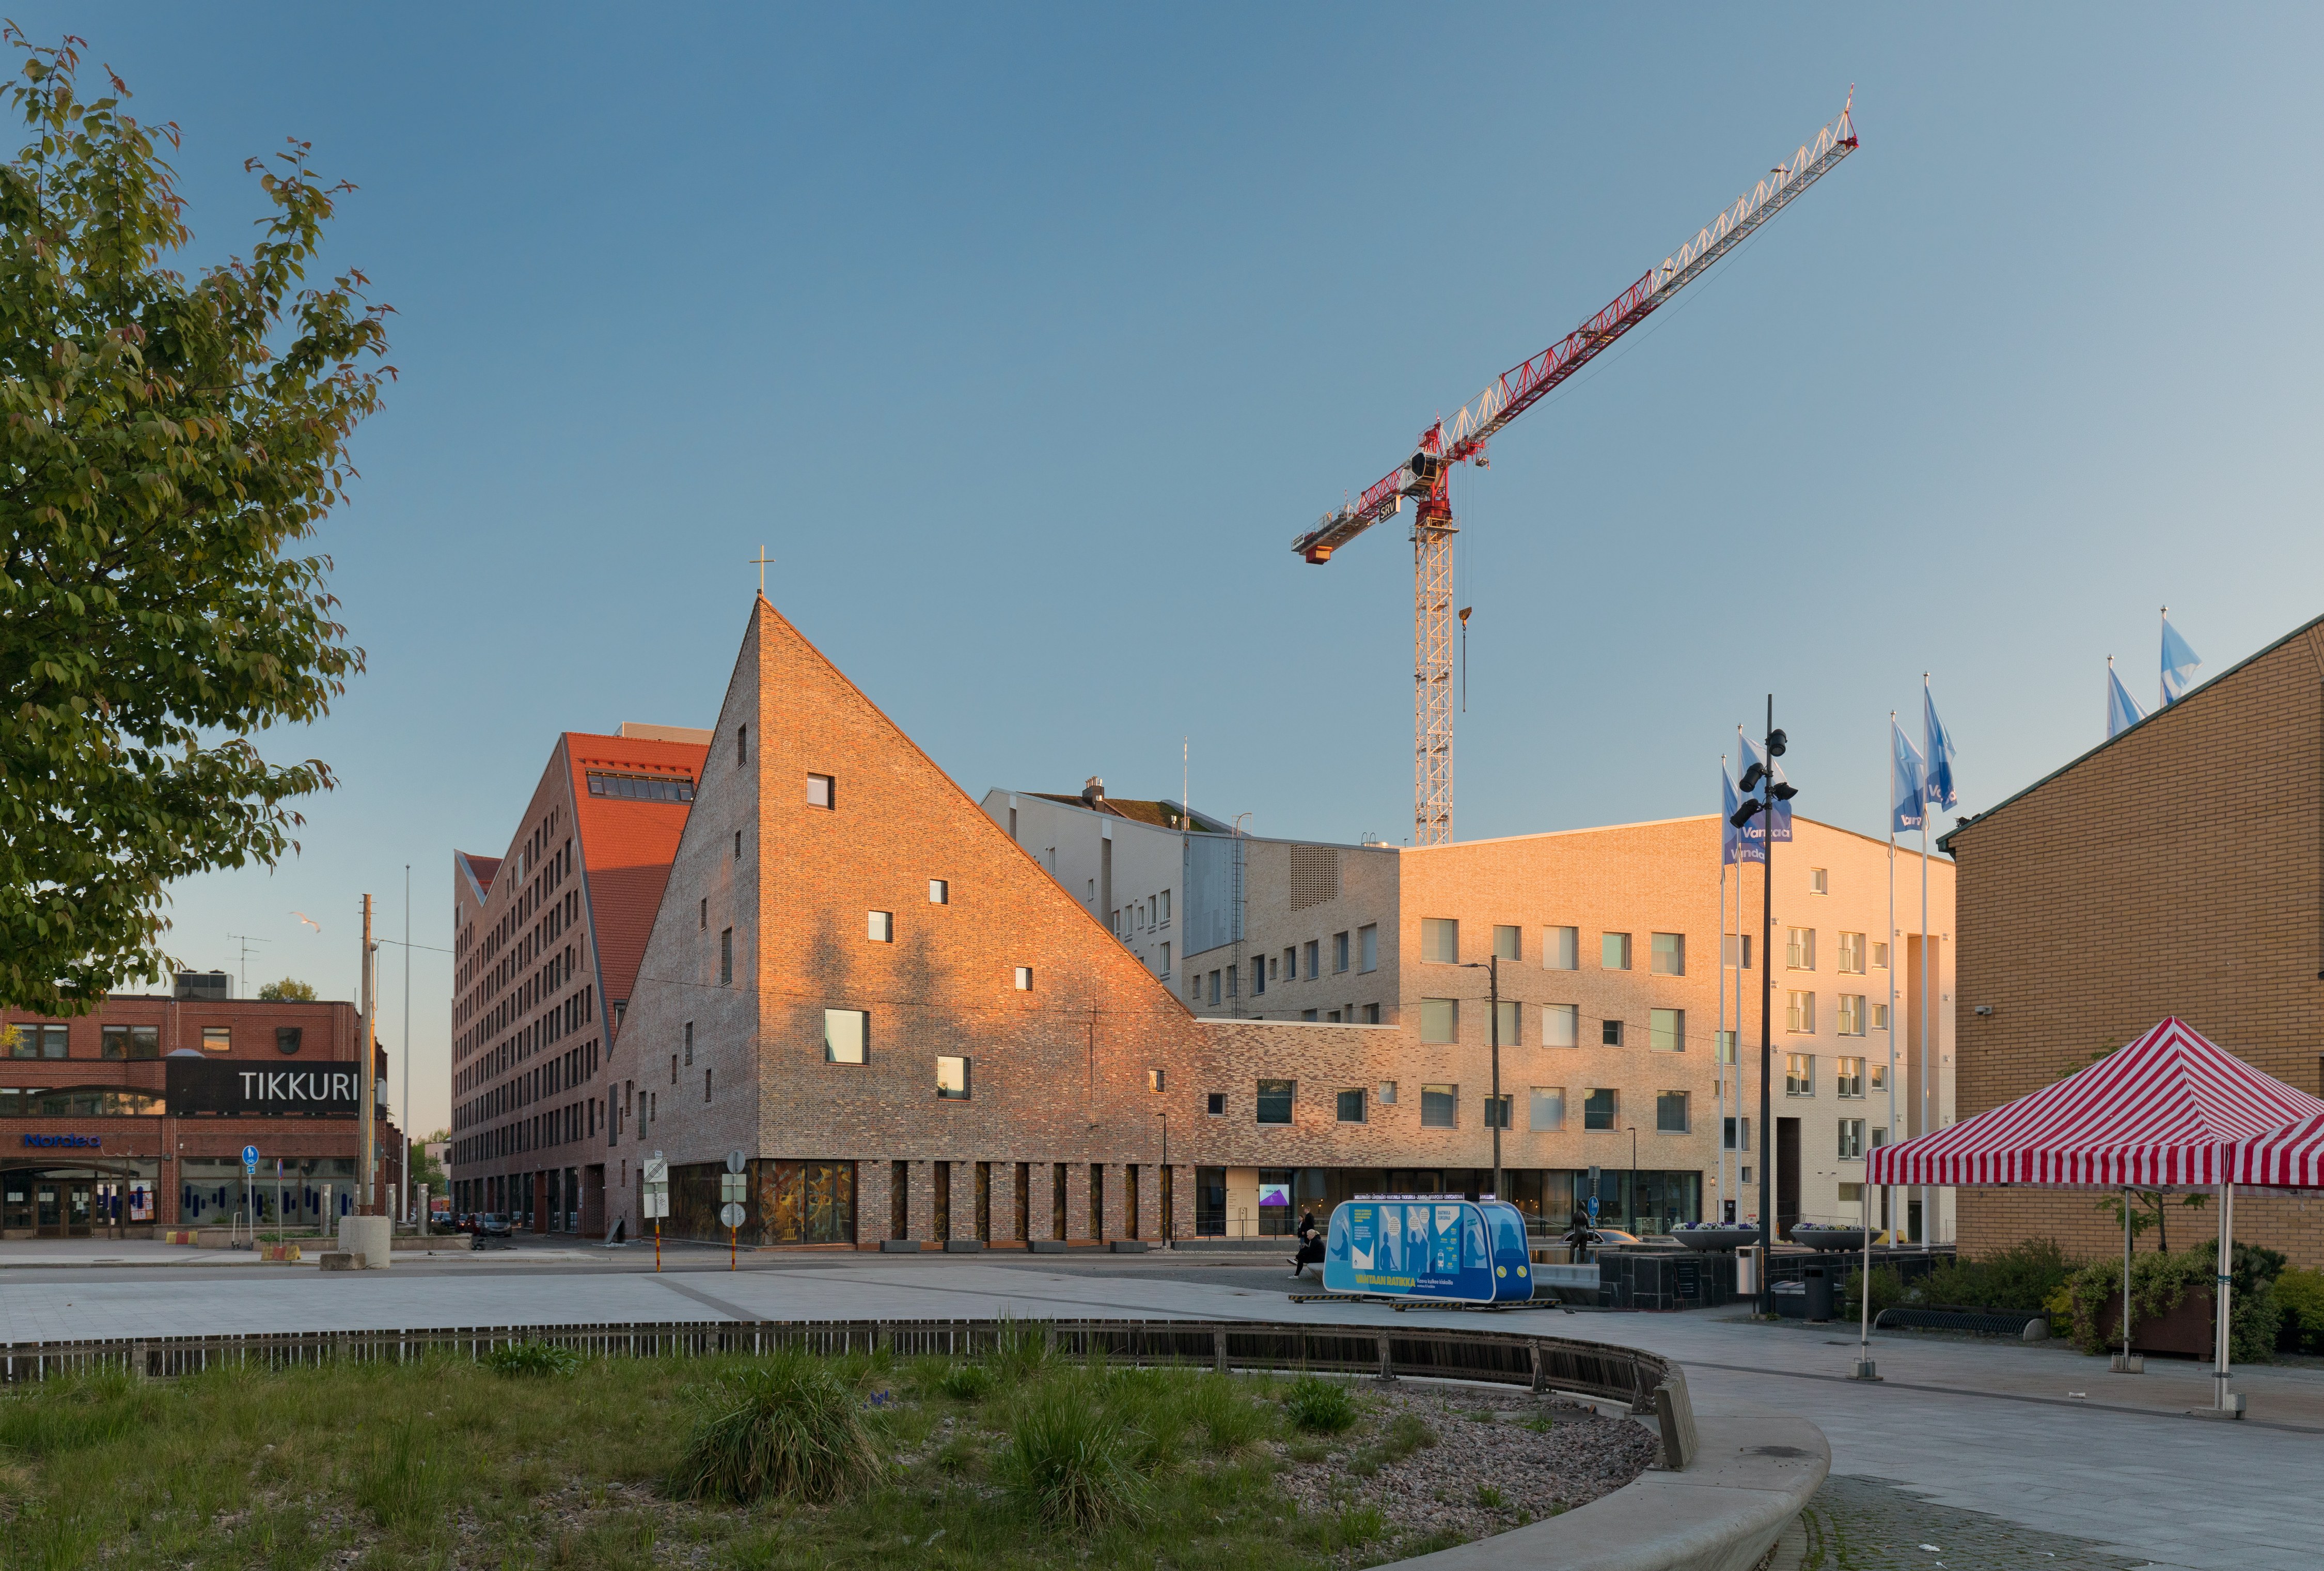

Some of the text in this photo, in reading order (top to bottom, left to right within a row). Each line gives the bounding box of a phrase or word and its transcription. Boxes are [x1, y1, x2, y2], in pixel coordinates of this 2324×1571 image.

[1380, 500, 1395, 518] SRV
[1742, 827, 1791, 838] Vanaa
[239, 1072, 358, 1100] TIKKURI
[25, 1133, 101, 1147] Nordea
[1355, 1274, 1416, 1287] VANTAAN RATIKKA
